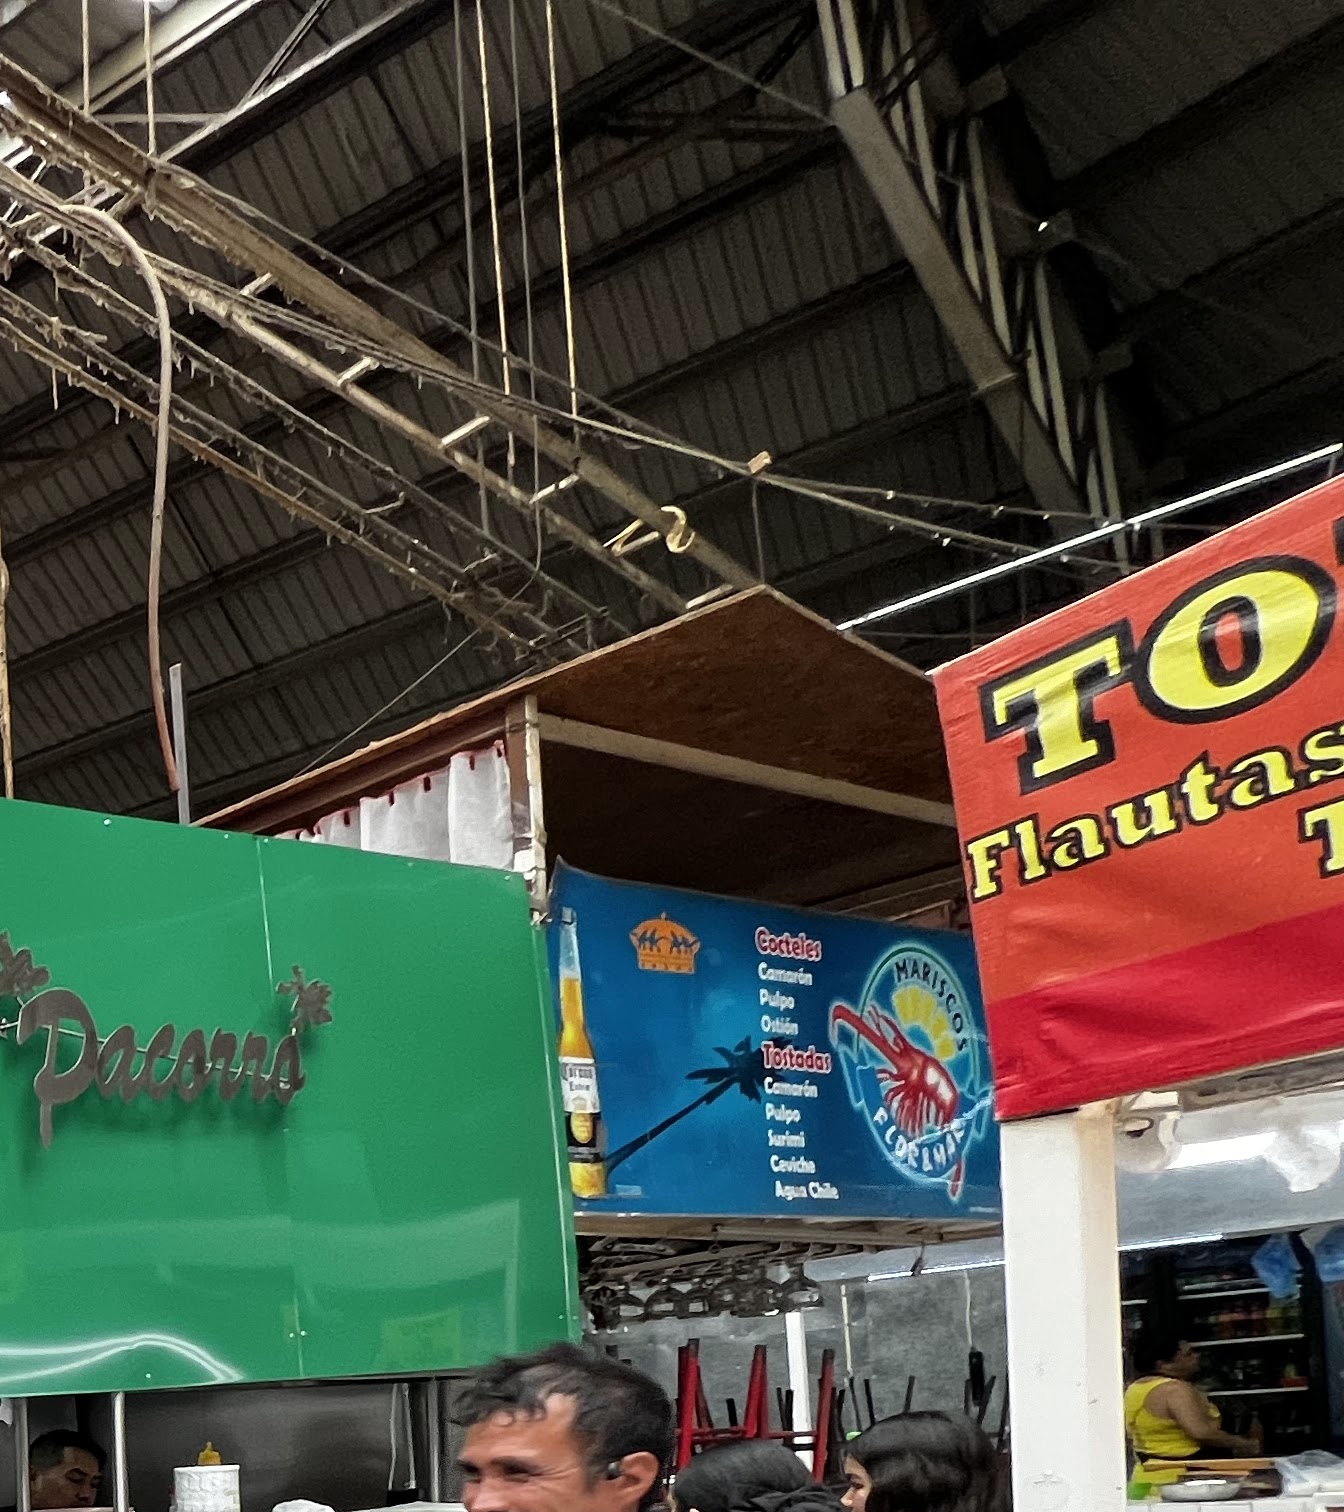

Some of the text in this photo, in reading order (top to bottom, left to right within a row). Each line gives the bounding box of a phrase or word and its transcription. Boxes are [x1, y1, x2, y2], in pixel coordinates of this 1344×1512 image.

[979, 515, 1344, 796] TO
[965, 717, 1344, 903] Flautas
[755, 926, 822, 962] Cocteles
[759, 988, 795, 1011] Pulpo
[894, 957, 968, 1052] MARISCOS
[761, 1041, 832, 1074] Tostadas
[765, 1102, 801, 1125] Pulpo
[770, 1154, 816, 1174] Ceviche
